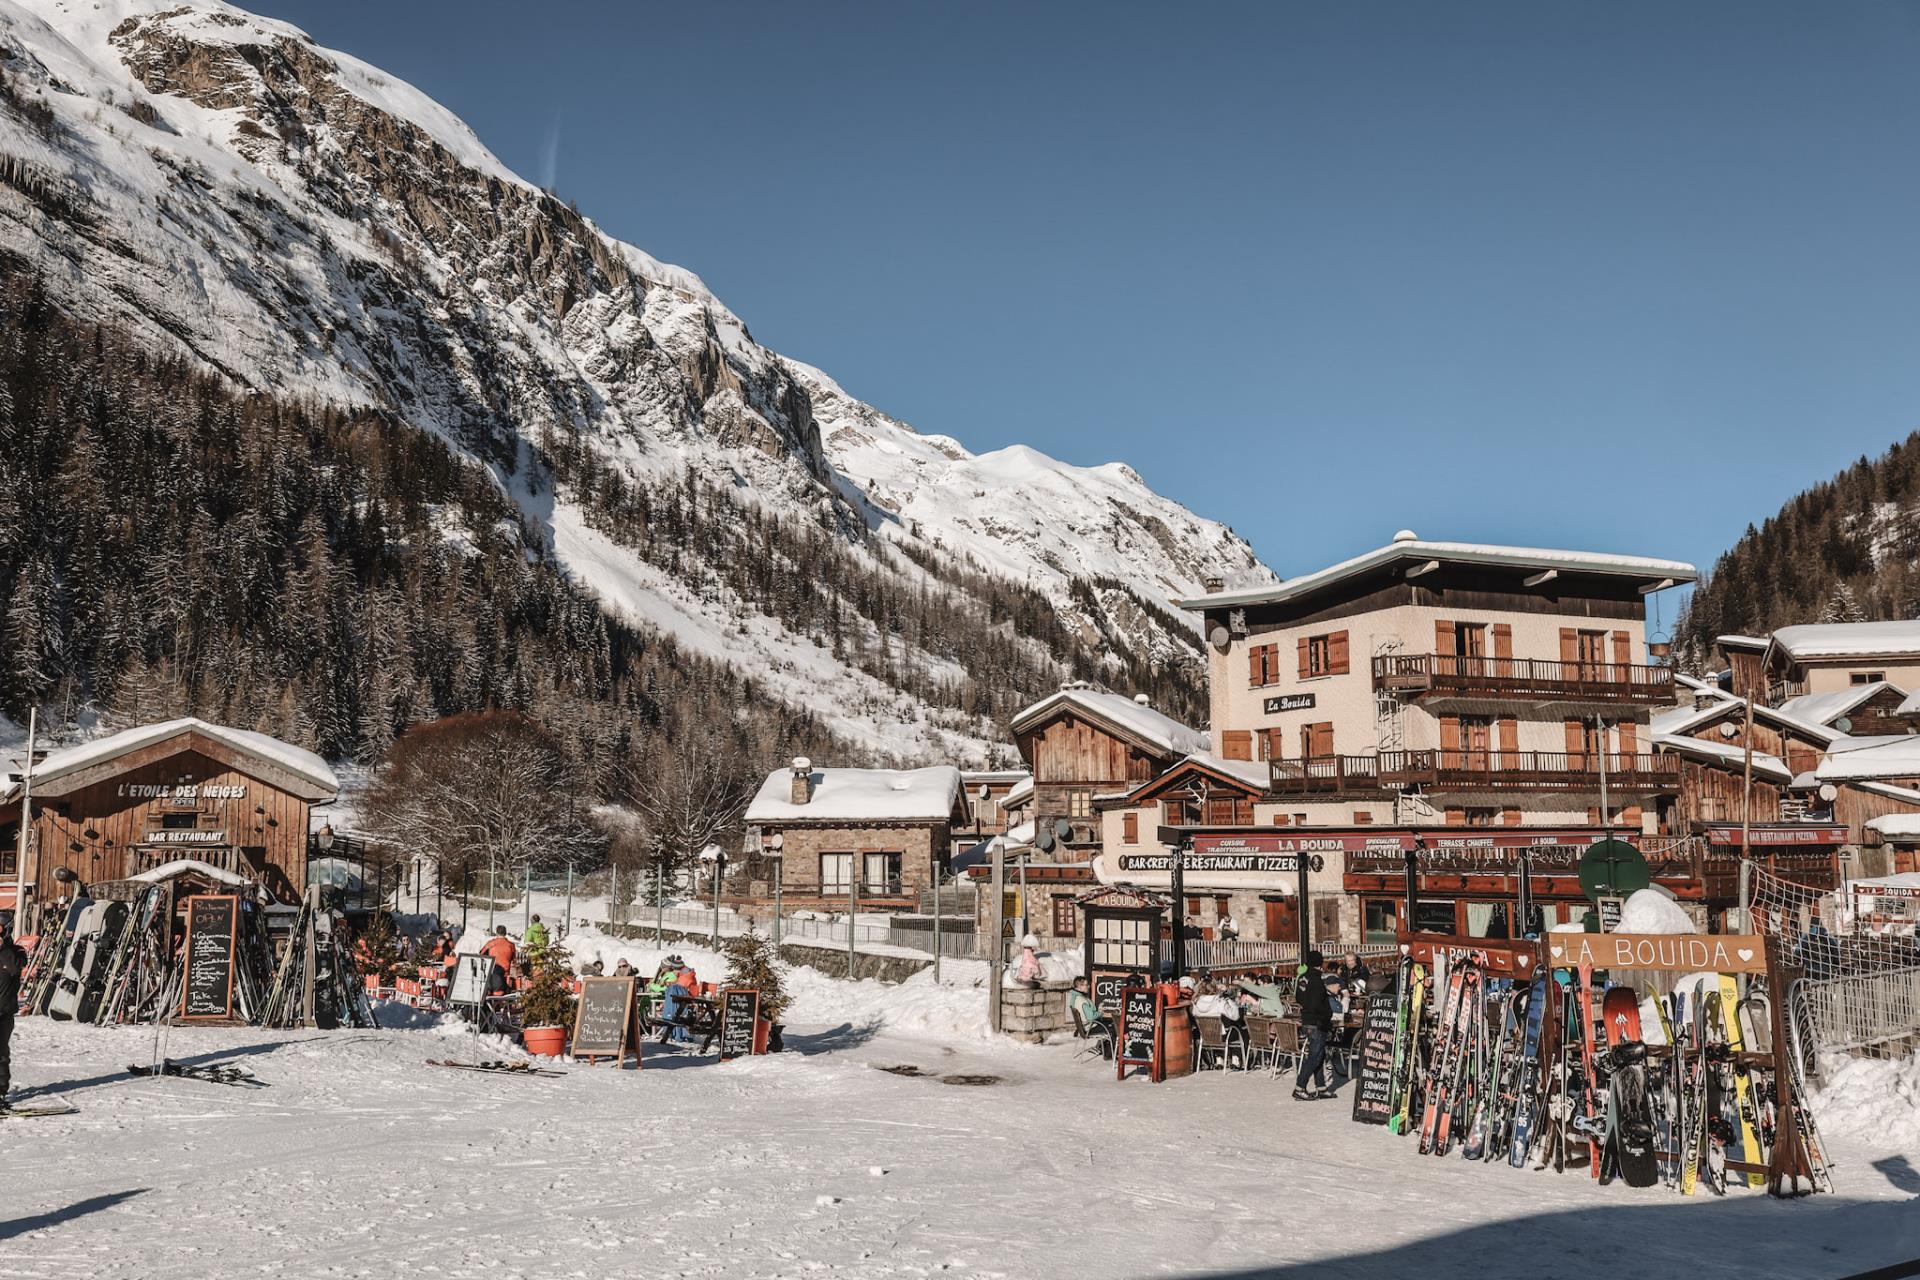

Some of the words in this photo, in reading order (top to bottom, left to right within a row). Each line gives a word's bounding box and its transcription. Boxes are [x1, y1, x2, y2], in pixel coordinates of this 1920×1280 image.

[1267, 699, 1279, 711] La
[1281, 696, 1311, 709] Bouida
[118, 783, 169, 798] L'ETOILE
[175, 785, 198, 797] DES
[202, 785, 246, 798] NEIGES
[148, 832, 165, 842] BAR
[168, 832, 223, 842] RESTAURANT
[1532, 837, 1538, 845] LA
[1278, 840, 1295, 850] LA
[1300, 839, 1345, 850] BOUIDA
[1437, 839, 1465, 848] TERRASSE
[1192, 856, 1254, 871] RESTAURANT
[1258, 856, 1299, 871] PIZZERI
[1099, 896, 1109, 906] LA
[1110, 895, 1140, 907] BOUIDA
[1564, 938, 1595, 964] LA
[1127, 1001, 1153, 1015] BAR
[1372, 998, 1393, 1007] LATTE
